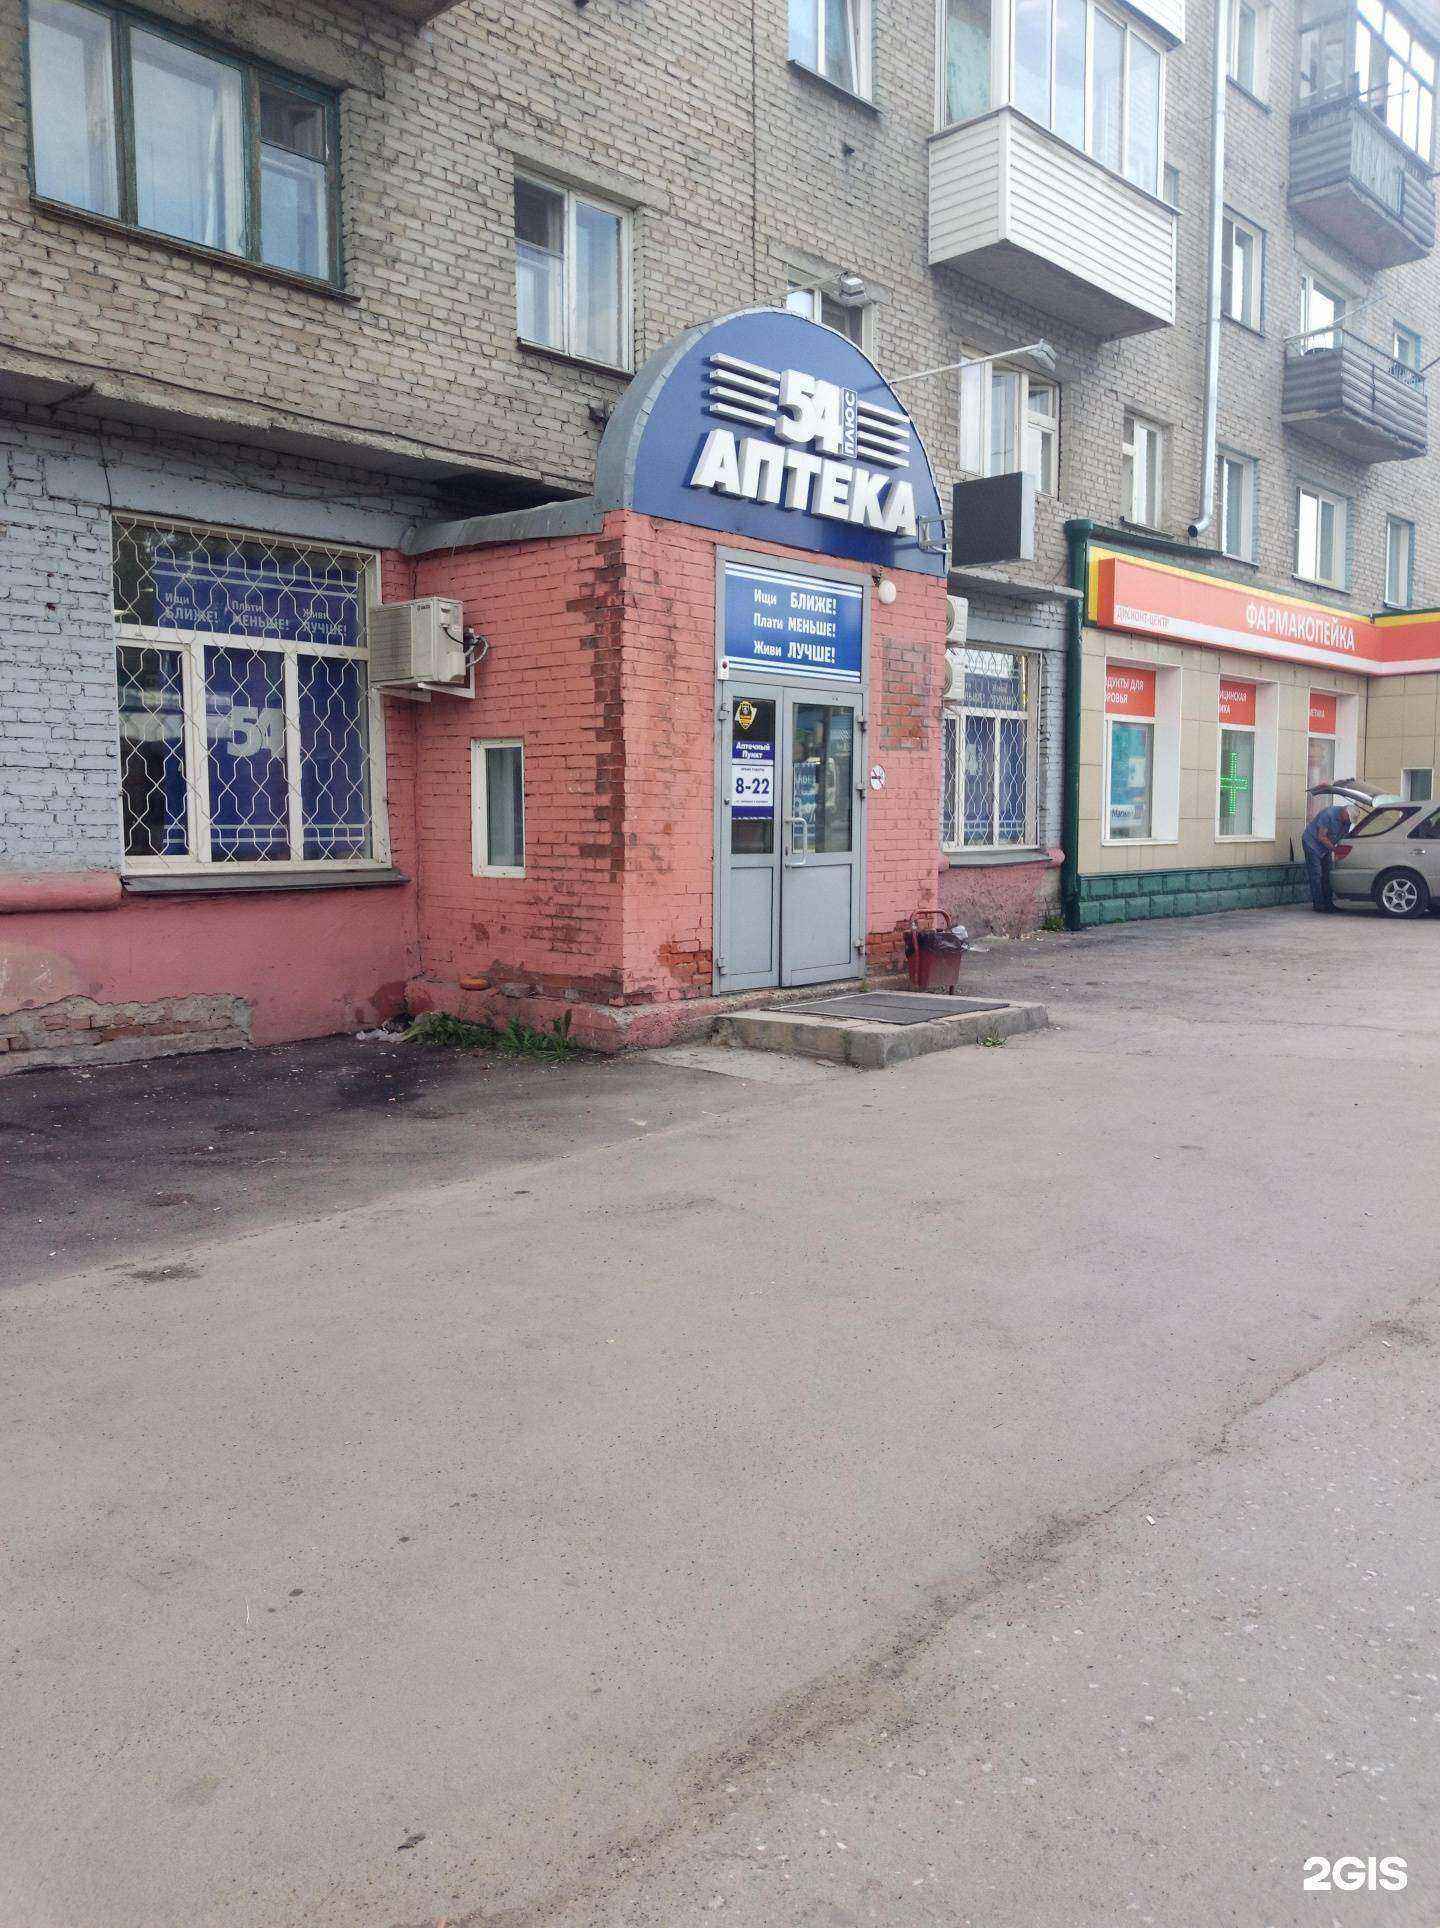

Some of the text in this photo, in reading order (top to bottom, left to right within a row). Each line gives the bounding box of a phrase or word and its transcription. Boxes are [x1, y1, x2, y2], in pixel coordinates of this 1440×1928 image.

[775, 369, 843, 455] 54
[844, 389, 856, 457] ПЛЮС
[690, 428, 917, 537] АПТЕКА
[754, 589, 837, 615] Ищи БЛИЖЕ!
[754, 612, 836, 638] Плати МЕНЬШЕ!
[1246, 601, 1355, 651] ФАРМАКОПЕЙКА
[754, 640, 835, 664] Живи ЛУЧШЕ!
[1130, 679, 1144, 692] ДЛЯ
[227, 706, 286, 757] 54
[736, 741, 770, 751] Аптечный
[742, 750, 763, 760] Пункт
[736, 778, 769, 794] 8-22
